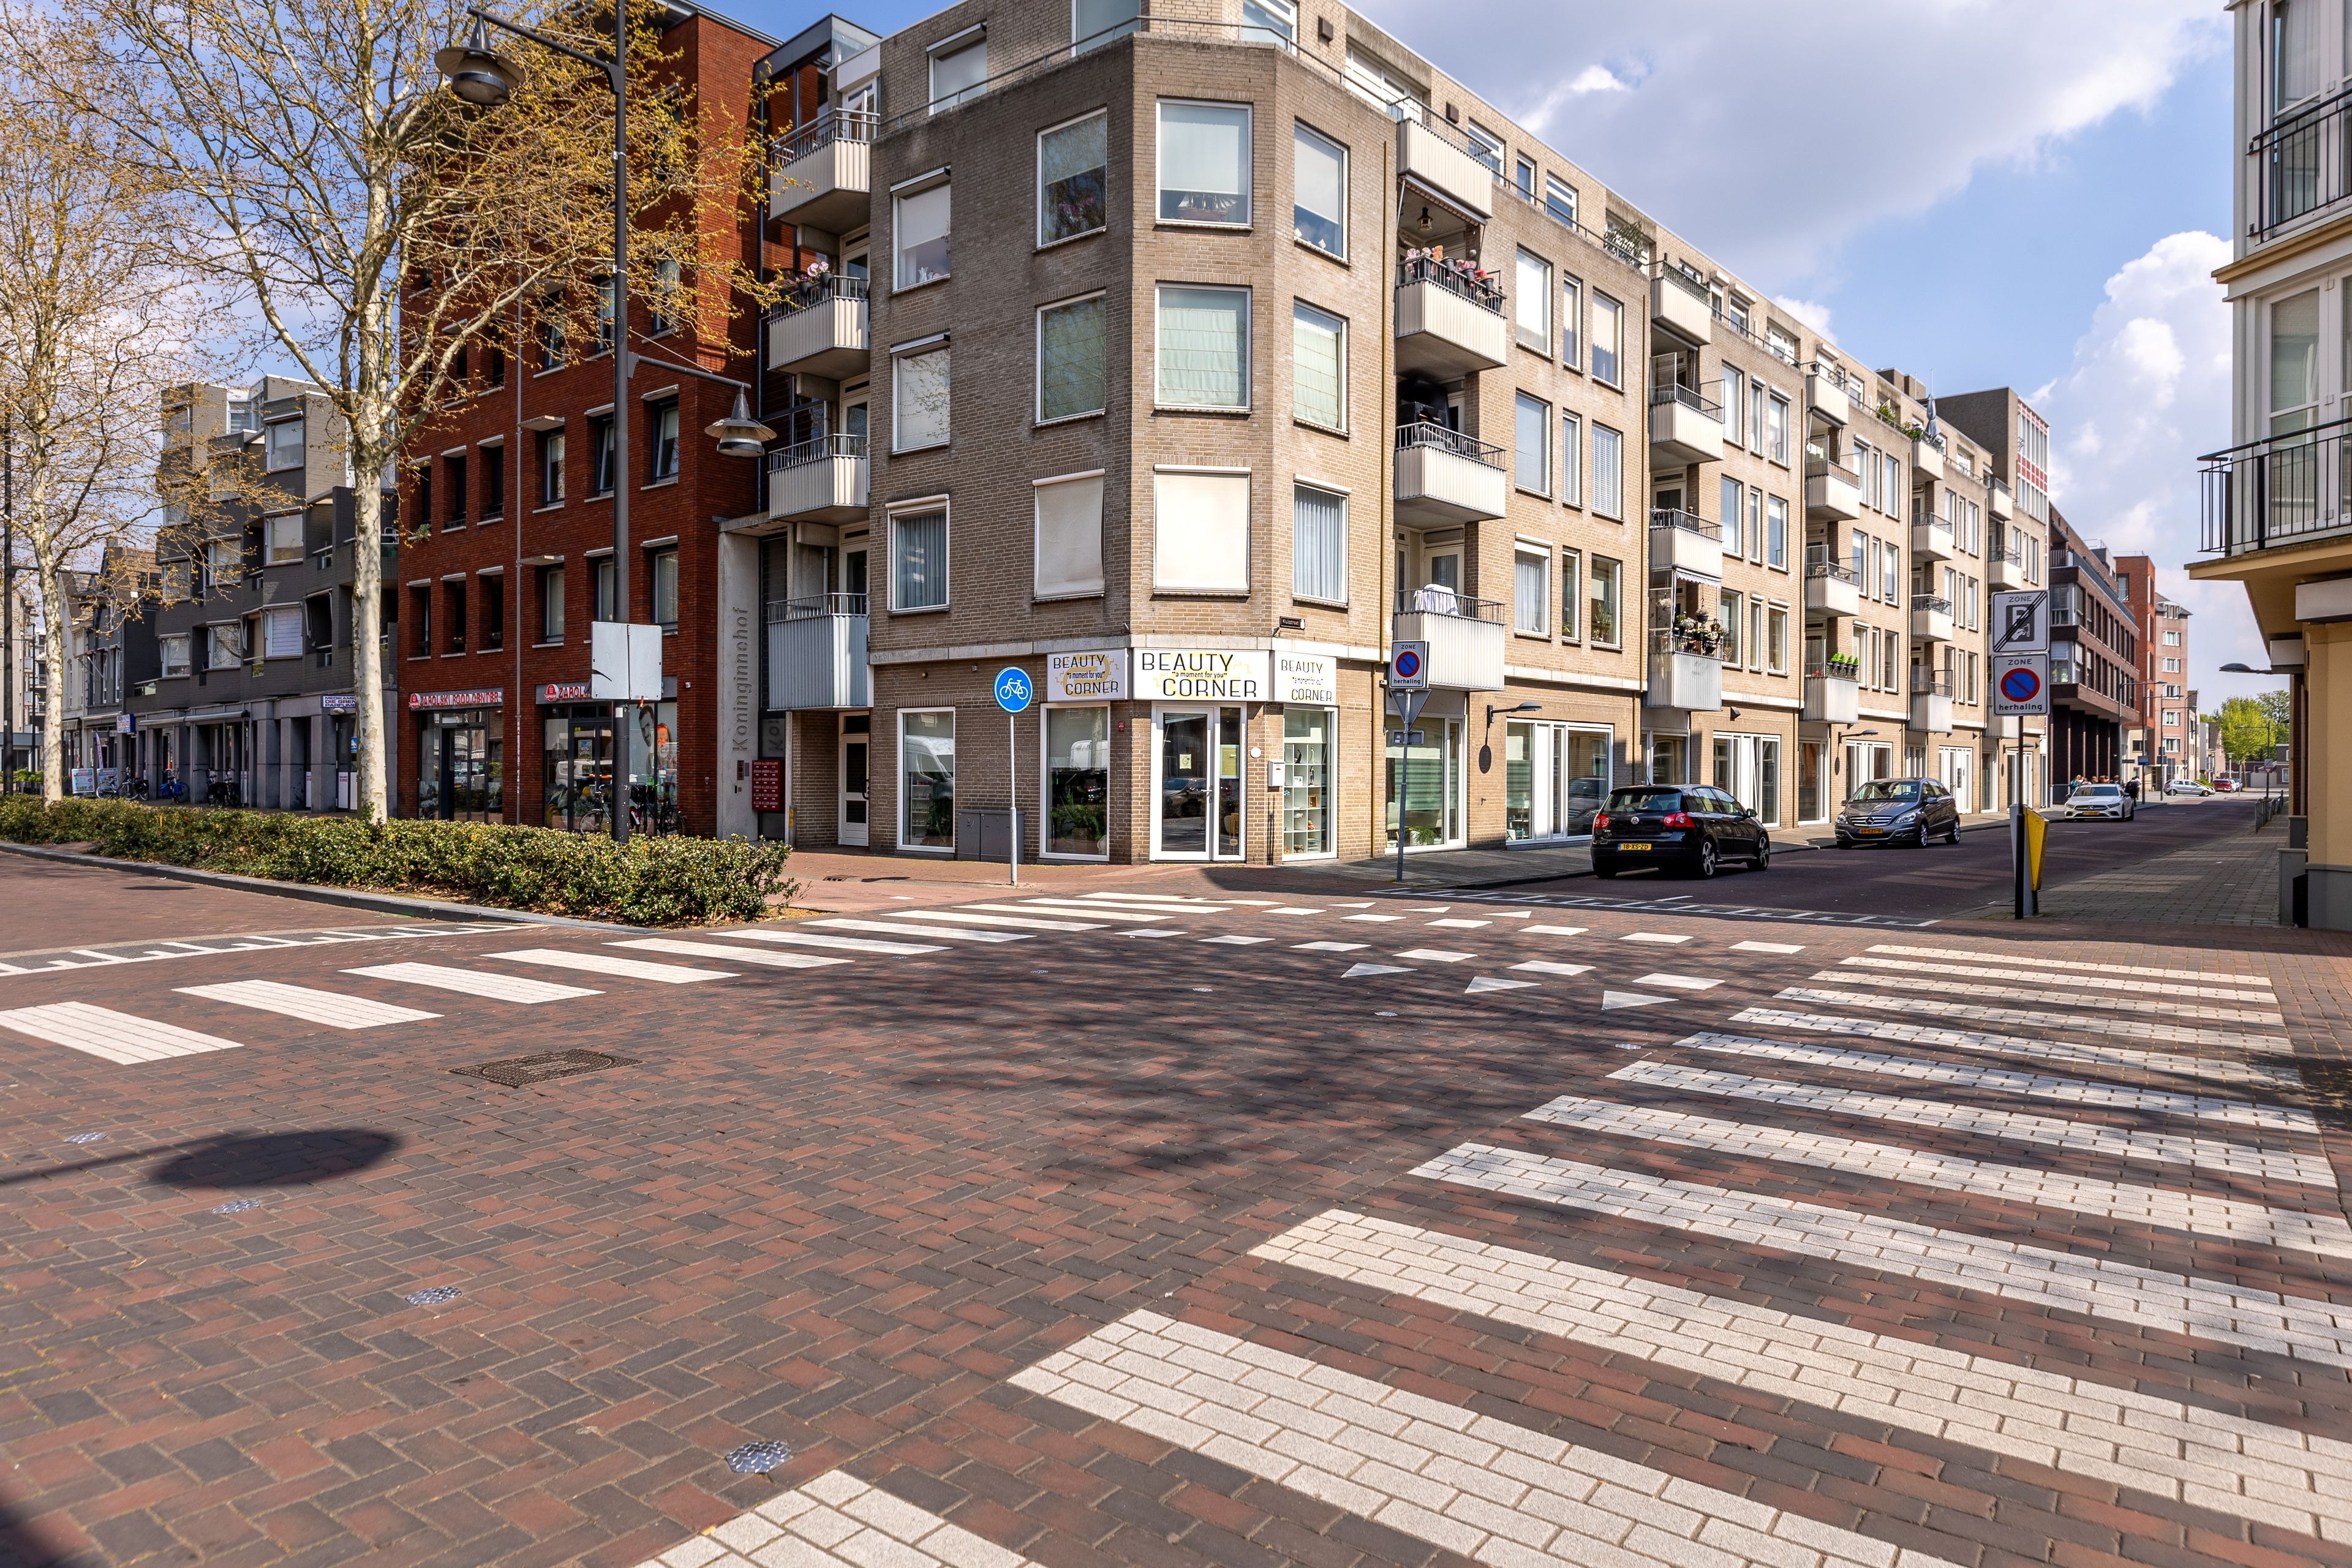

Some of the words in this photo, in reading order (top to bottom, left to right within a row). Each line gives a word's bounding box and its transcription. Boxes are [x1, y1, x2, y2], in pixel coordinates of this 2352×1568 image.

[1054, 654, 1106, 669] BEAUTY
[1142, 653, 1234, 671] BEAUTY
[1281, 659, 1323, 674] BEAUTY
[1066, 681, 1118, 695] CORNER
[1163, 678, 1256, 697] CORNER
[420, 695, 450, 706] ZAPOLSKI
[452, 693, 470, 705] FOOD
[472, 692, 499, 704] CENTER
[1292, 688, 1332, 702] CORNER
[1999, 703, 2043, 712] herhaling
